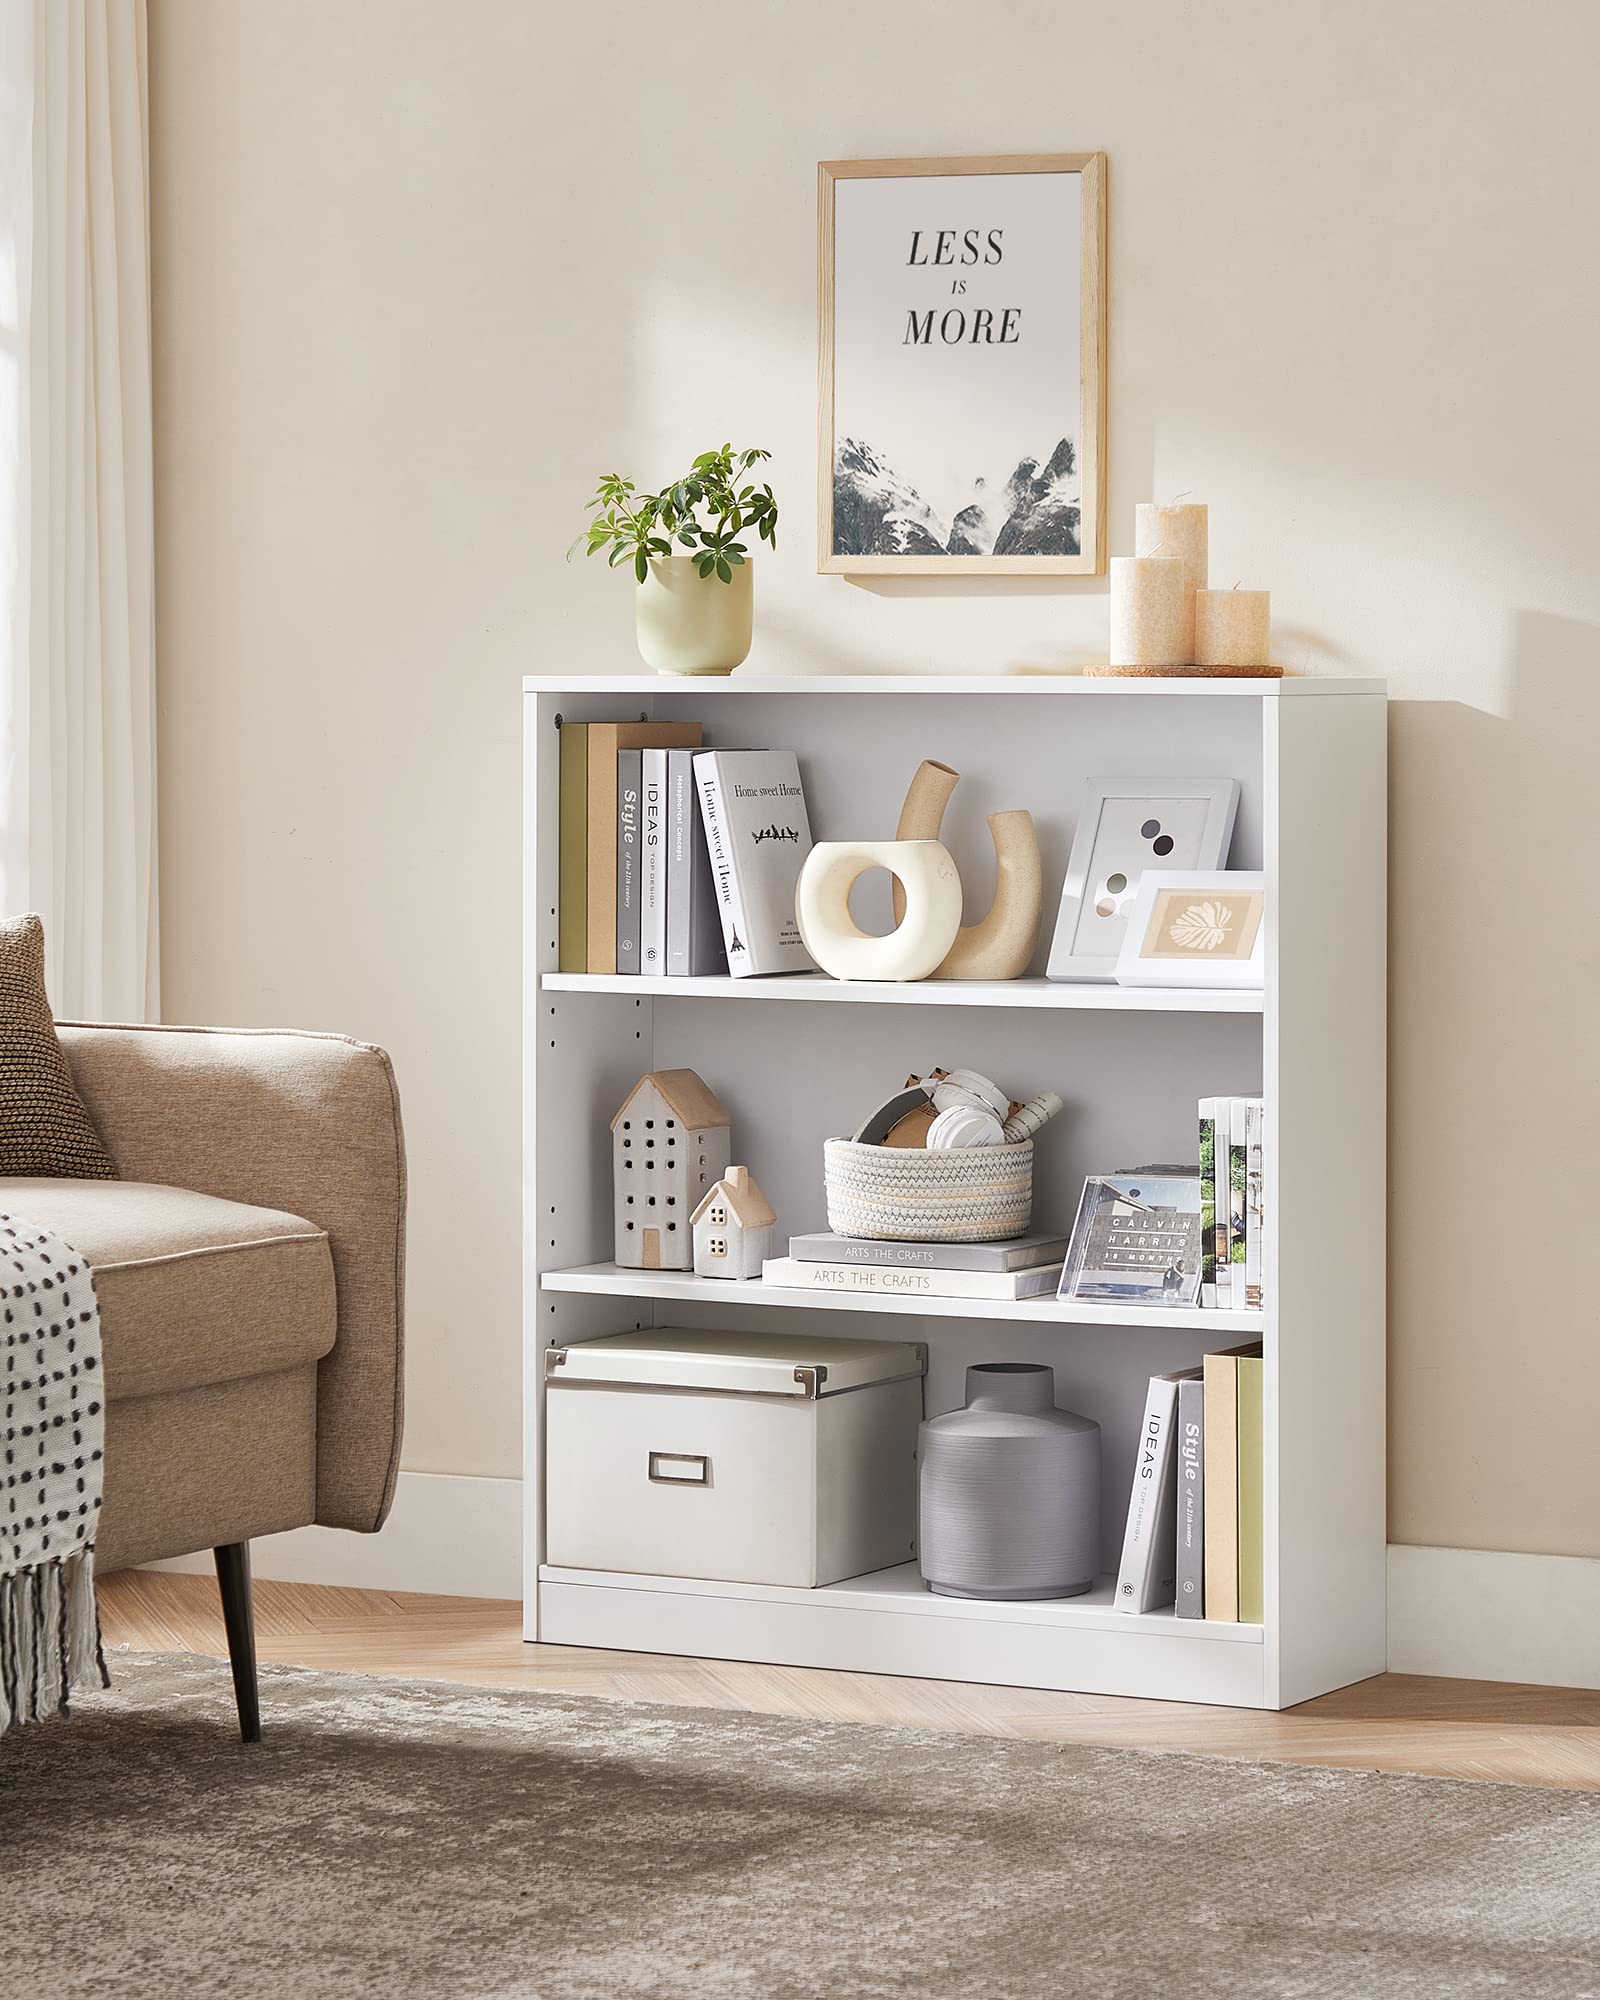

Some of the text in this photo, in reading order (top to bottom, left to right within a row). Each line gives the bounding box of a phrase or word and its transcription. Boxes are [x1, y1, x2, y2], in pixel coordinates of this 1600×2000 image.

[906, 229, 1004, 266] LESS
[951, 280, 967, 295] IS
[902, 308, 1021, 345] MORE
[734, 783, 801, 797] Home sweet Home
[621, 790, 637, 844] Style
[648, 783, 658, 846] IDEAS
[703, 781, 731, 905] Home sweet Home
[1112, 1218, 1191, 1230] CALVIN
[845, 1247, 934, 1261] ARTS THE CRAFTS
[1108, 1235, 1187, 1247] HARRIS
[1104, 1252, 1186, 1263] 18 MONTHS
[813, 1270, 930, 1288] ARTS THE CRAFTS
[1141, 1413, 1161, 1480] IDEAS
[1182, 1423, 1200, 1480] Style
